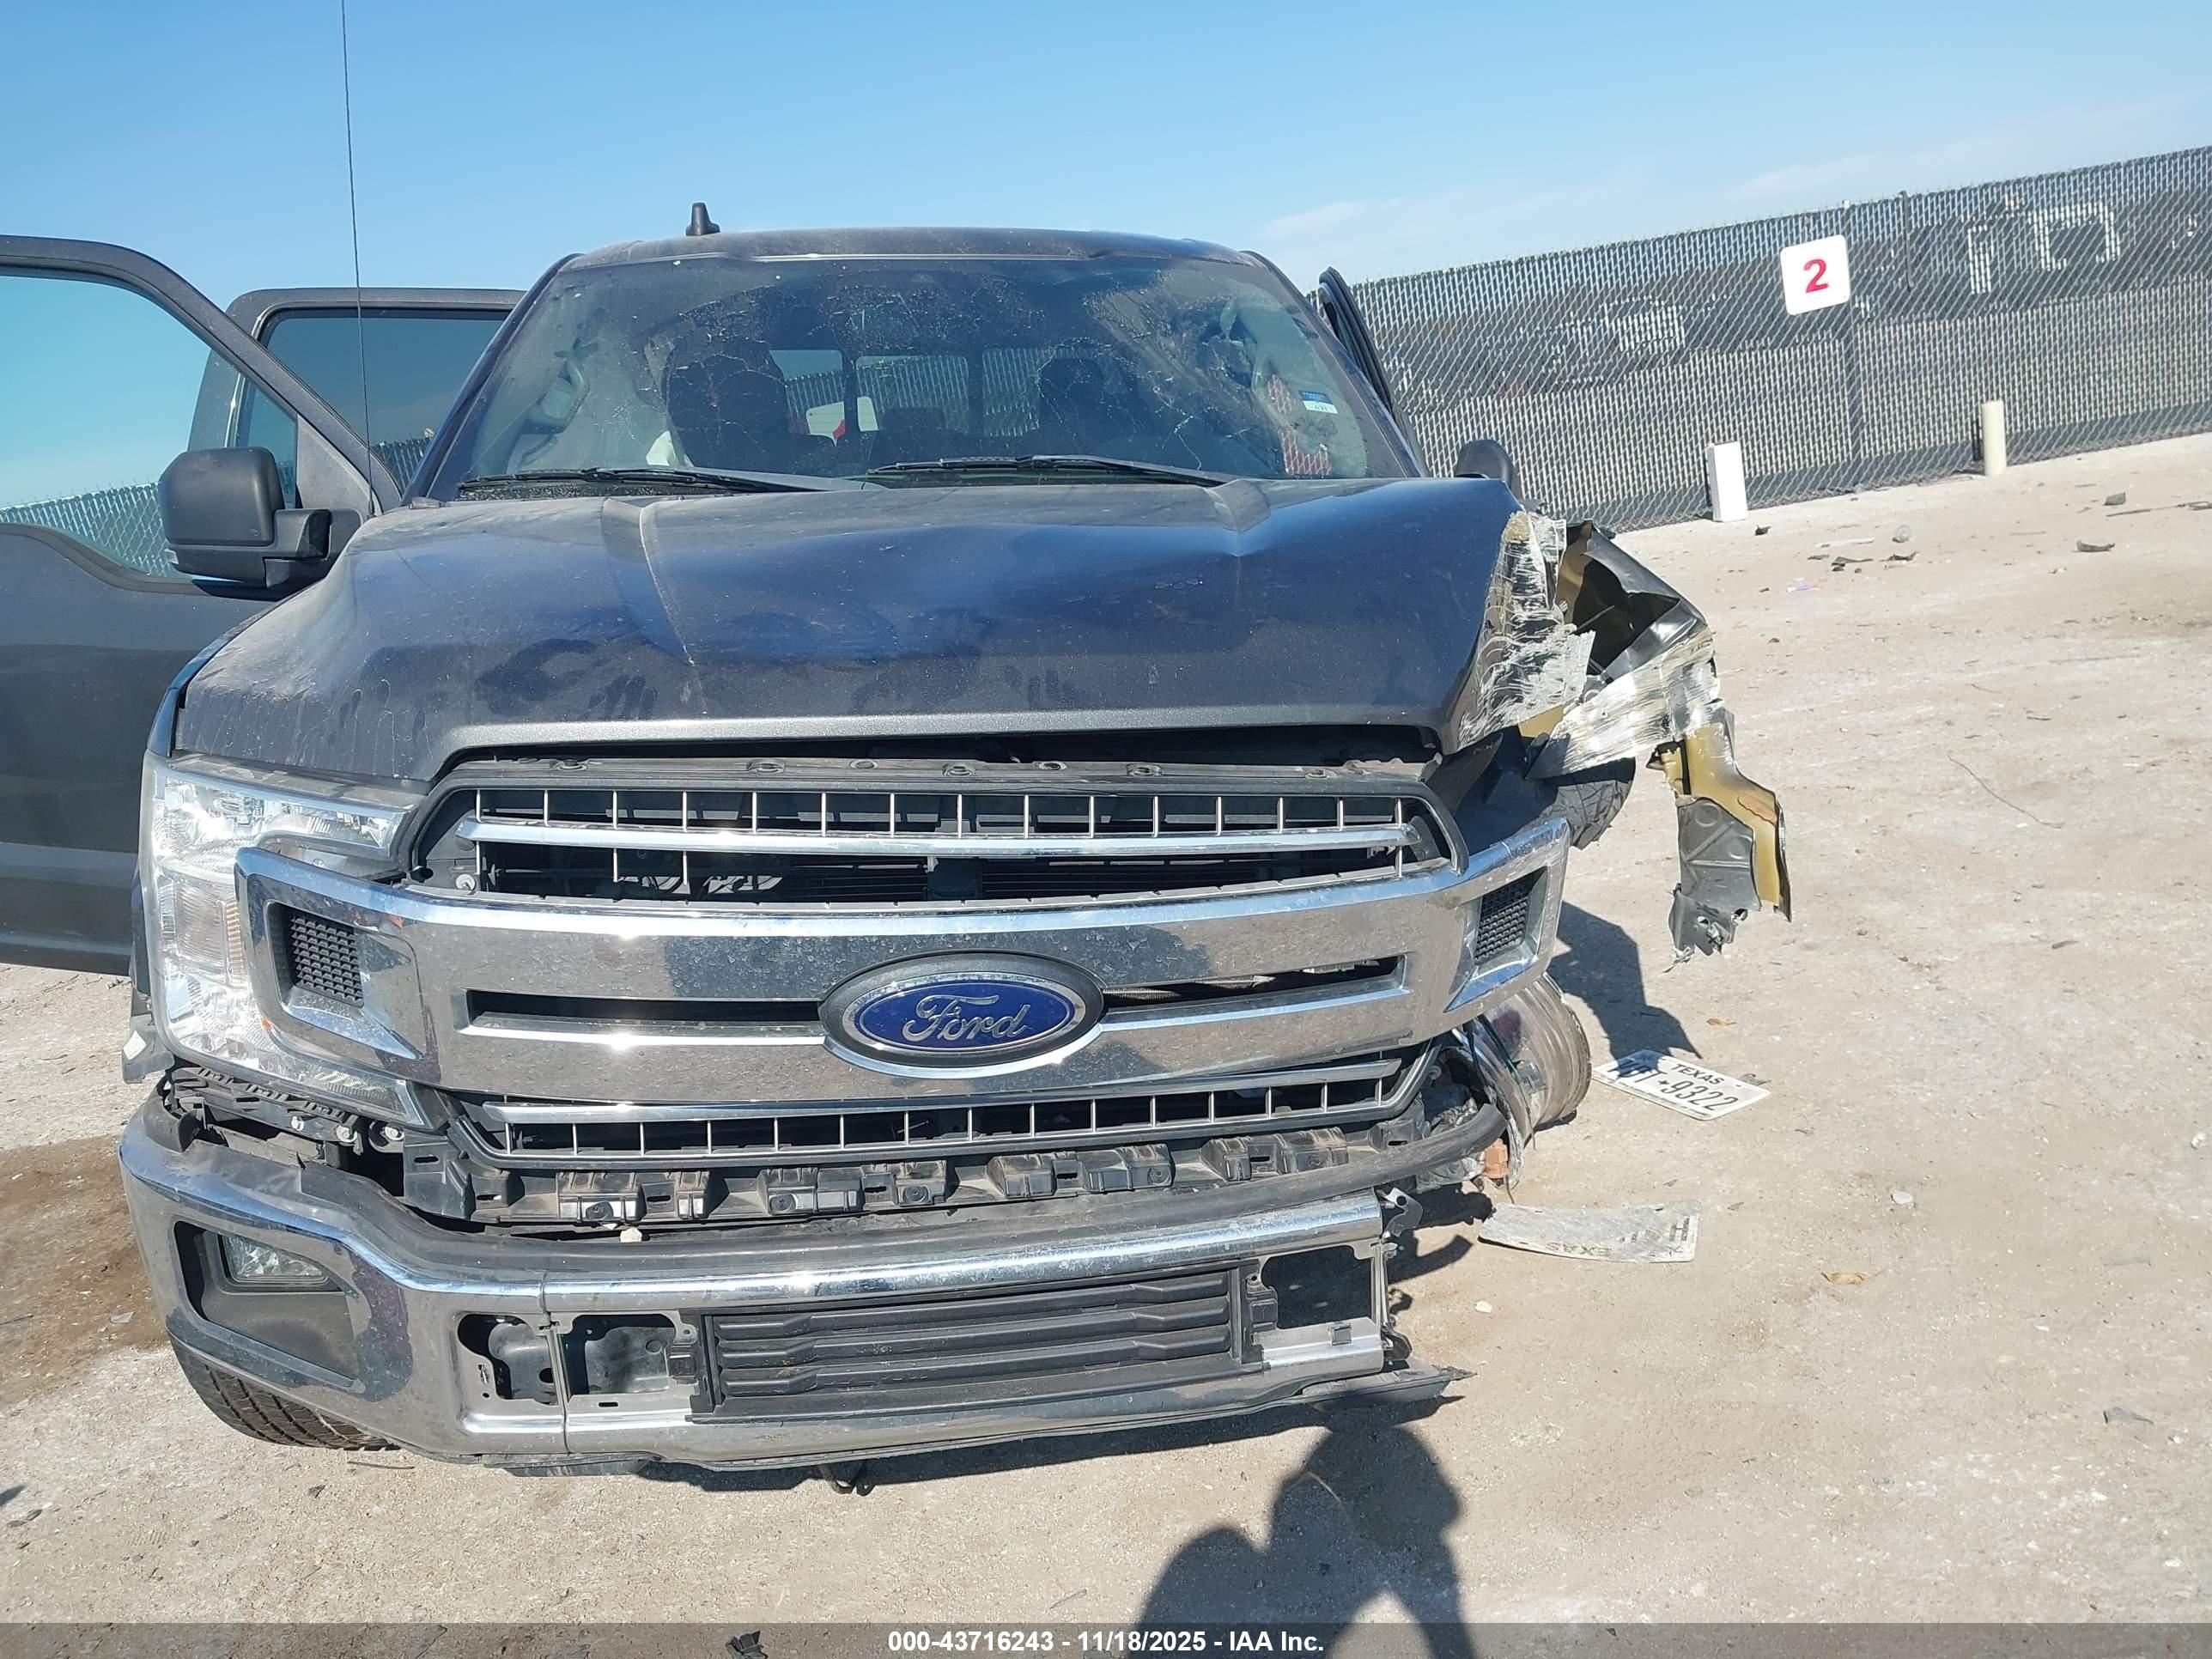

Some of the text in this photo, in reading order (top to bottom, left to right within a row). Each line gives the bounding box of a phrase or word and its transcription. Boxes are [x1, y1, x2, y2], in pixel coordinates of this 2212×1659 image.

[1803, 258, 1829, 294] 2
[902, 994, 1033, 1042] Ford
[1671, 1063, 1724, 1085] TEXAS
